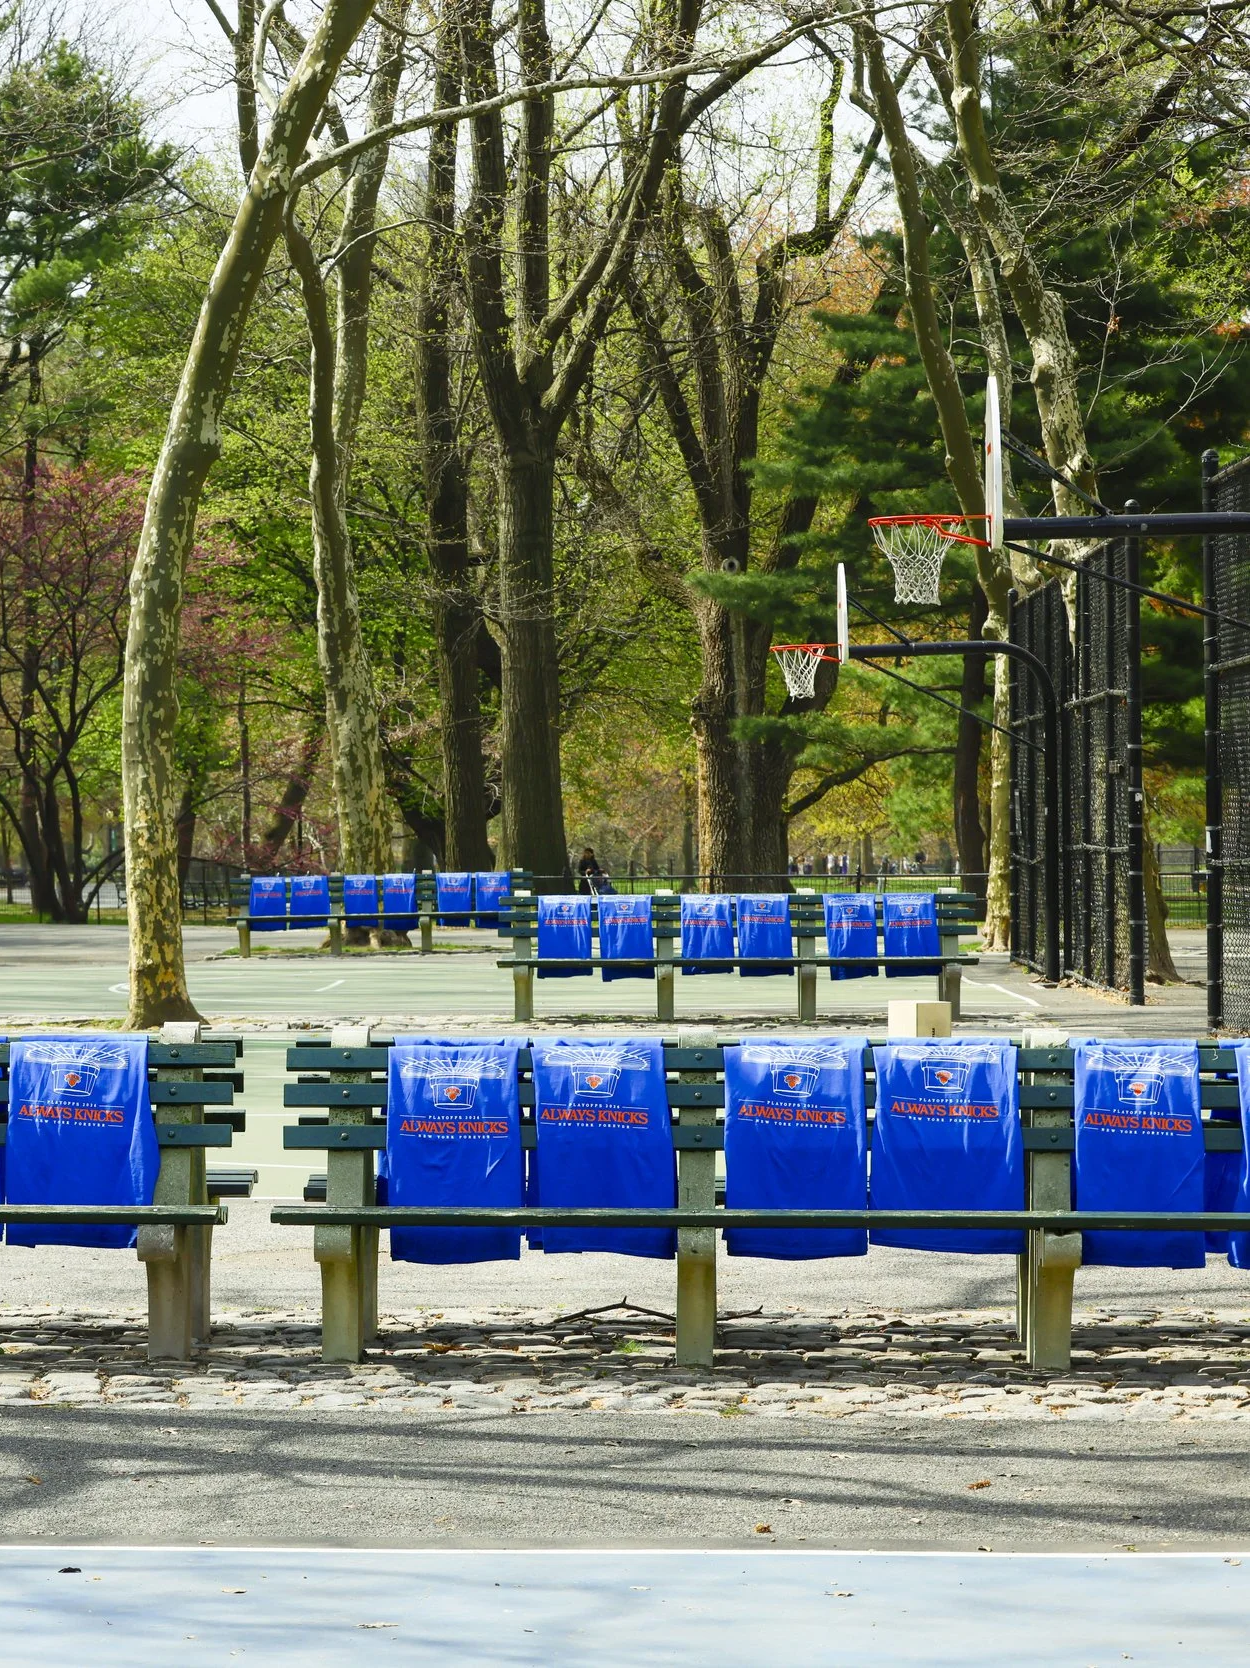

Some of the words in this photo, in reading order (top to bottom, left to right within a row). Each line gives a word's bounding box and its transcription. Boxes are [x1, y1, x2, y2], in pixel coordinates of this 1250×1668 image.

[18, 1104, 72, 1119] ALWAYS
[74, 1107, 124, 1123] KNICKS
[540, 1108, 596, 1122] ALWAYS
[597, 1110, 649, 1125] KNICKS
[738, 1104, 793, 1120] ALWAYS
[795, 1109, 847, 1124] KNICKS
[890, 1101, 947, 1117] ALWAYS
[949, 1104, 999, 1118] KNICKS
[399, 1120, 456, 1134] ALWAYS
[457, 1121, 509, 1134] KNICKS
[1084, 1113, 1140, 1129] ALWAYS
[1141, 1117, 1193, 1132] KNICKS
